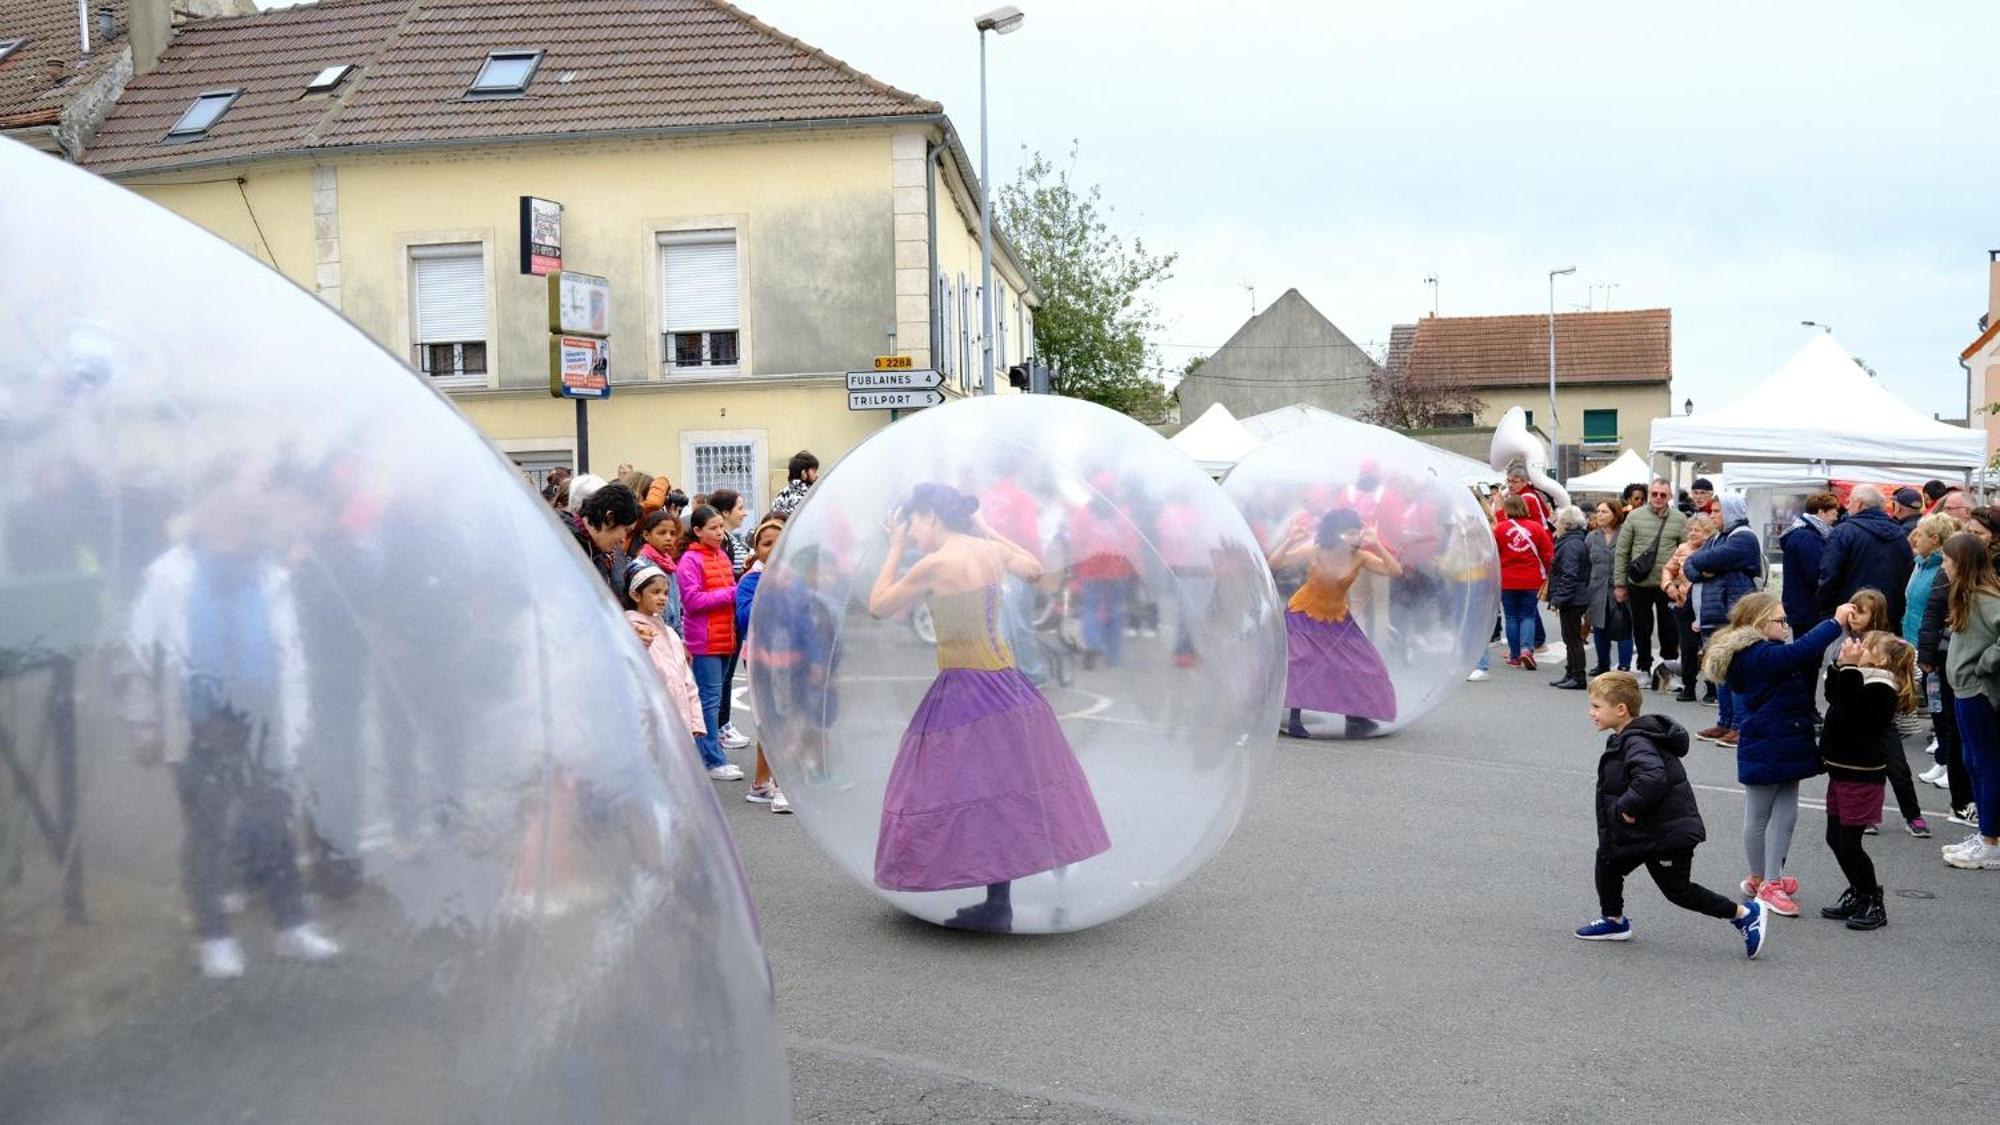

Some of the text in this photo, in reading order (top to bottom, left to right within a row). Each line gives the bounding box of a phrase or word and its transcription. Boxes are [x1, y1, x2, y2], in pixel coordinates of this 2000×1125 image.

[875, 359, 881, 368] D
[851, 375, 932, 385] FUBLAINES 4
[853, 394, 932, 405] TRILPORT 5
[721, 408, 726, 417] 2
